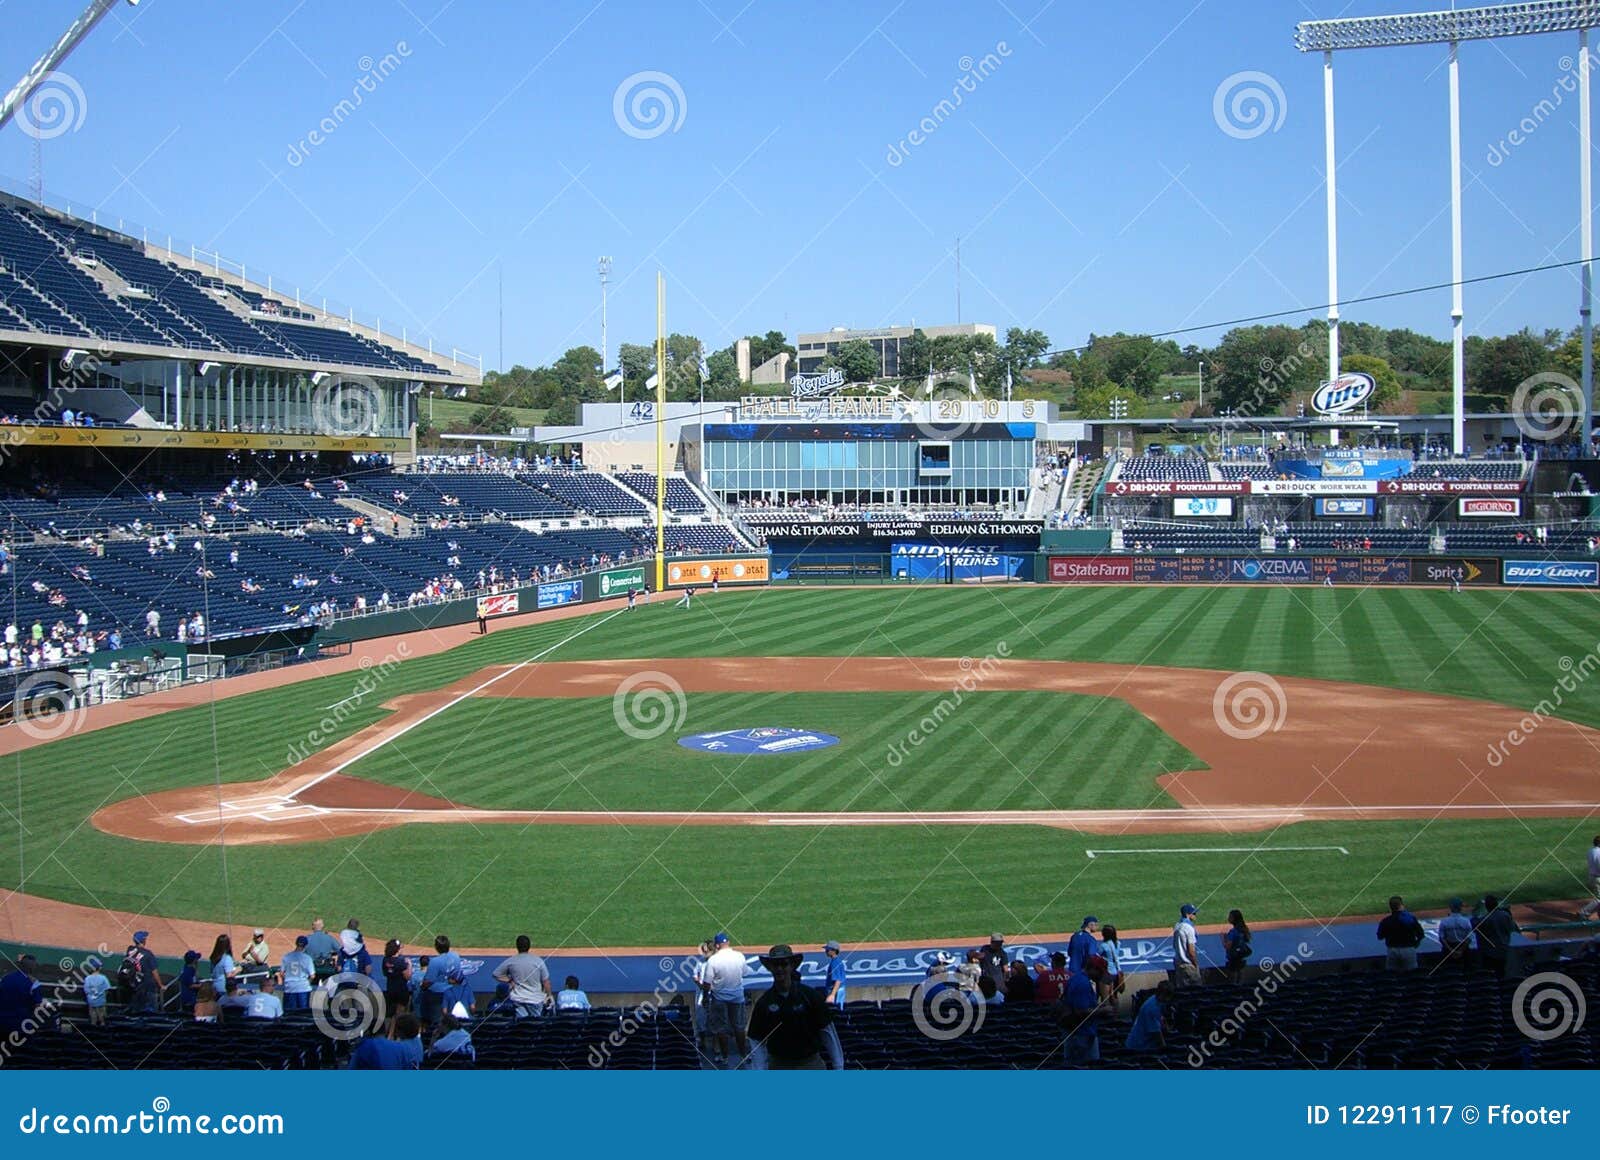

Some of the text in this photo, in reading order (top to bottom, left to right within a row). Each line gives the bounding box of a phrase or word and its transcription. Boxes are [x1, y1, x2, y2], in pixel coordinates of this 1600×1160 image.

[791, 368, 844, 397] Royals
[1324, 384, 1365, 410] Lite
[630, 402, 653, 420] 42
[740, 396, 896, 422] HALL of FAME
[940, 400, 962, 418] 20
[982, 400, 999, 418] 10
[1023, 399, 1035, 418] 5
[749, 524, 859, 536] DELMAN & THOMPSON
[930, 525, 974, 534] EDELMAN
[978, 523, 990, 534] &
[896, 545, 1000, 558] MIDWEST
[681, 568, 696, 577] at&t
[746, 566, 764, 574] at&t
[1068, 564, 1129, 576] State Farm
[1233, 560, 1307, 578] NOXZEMA
[1507, 567, 1594, 577] BUD LIGHT
[290, 961, 299, 976] 5
[255, 998, 264, 1012] 5
